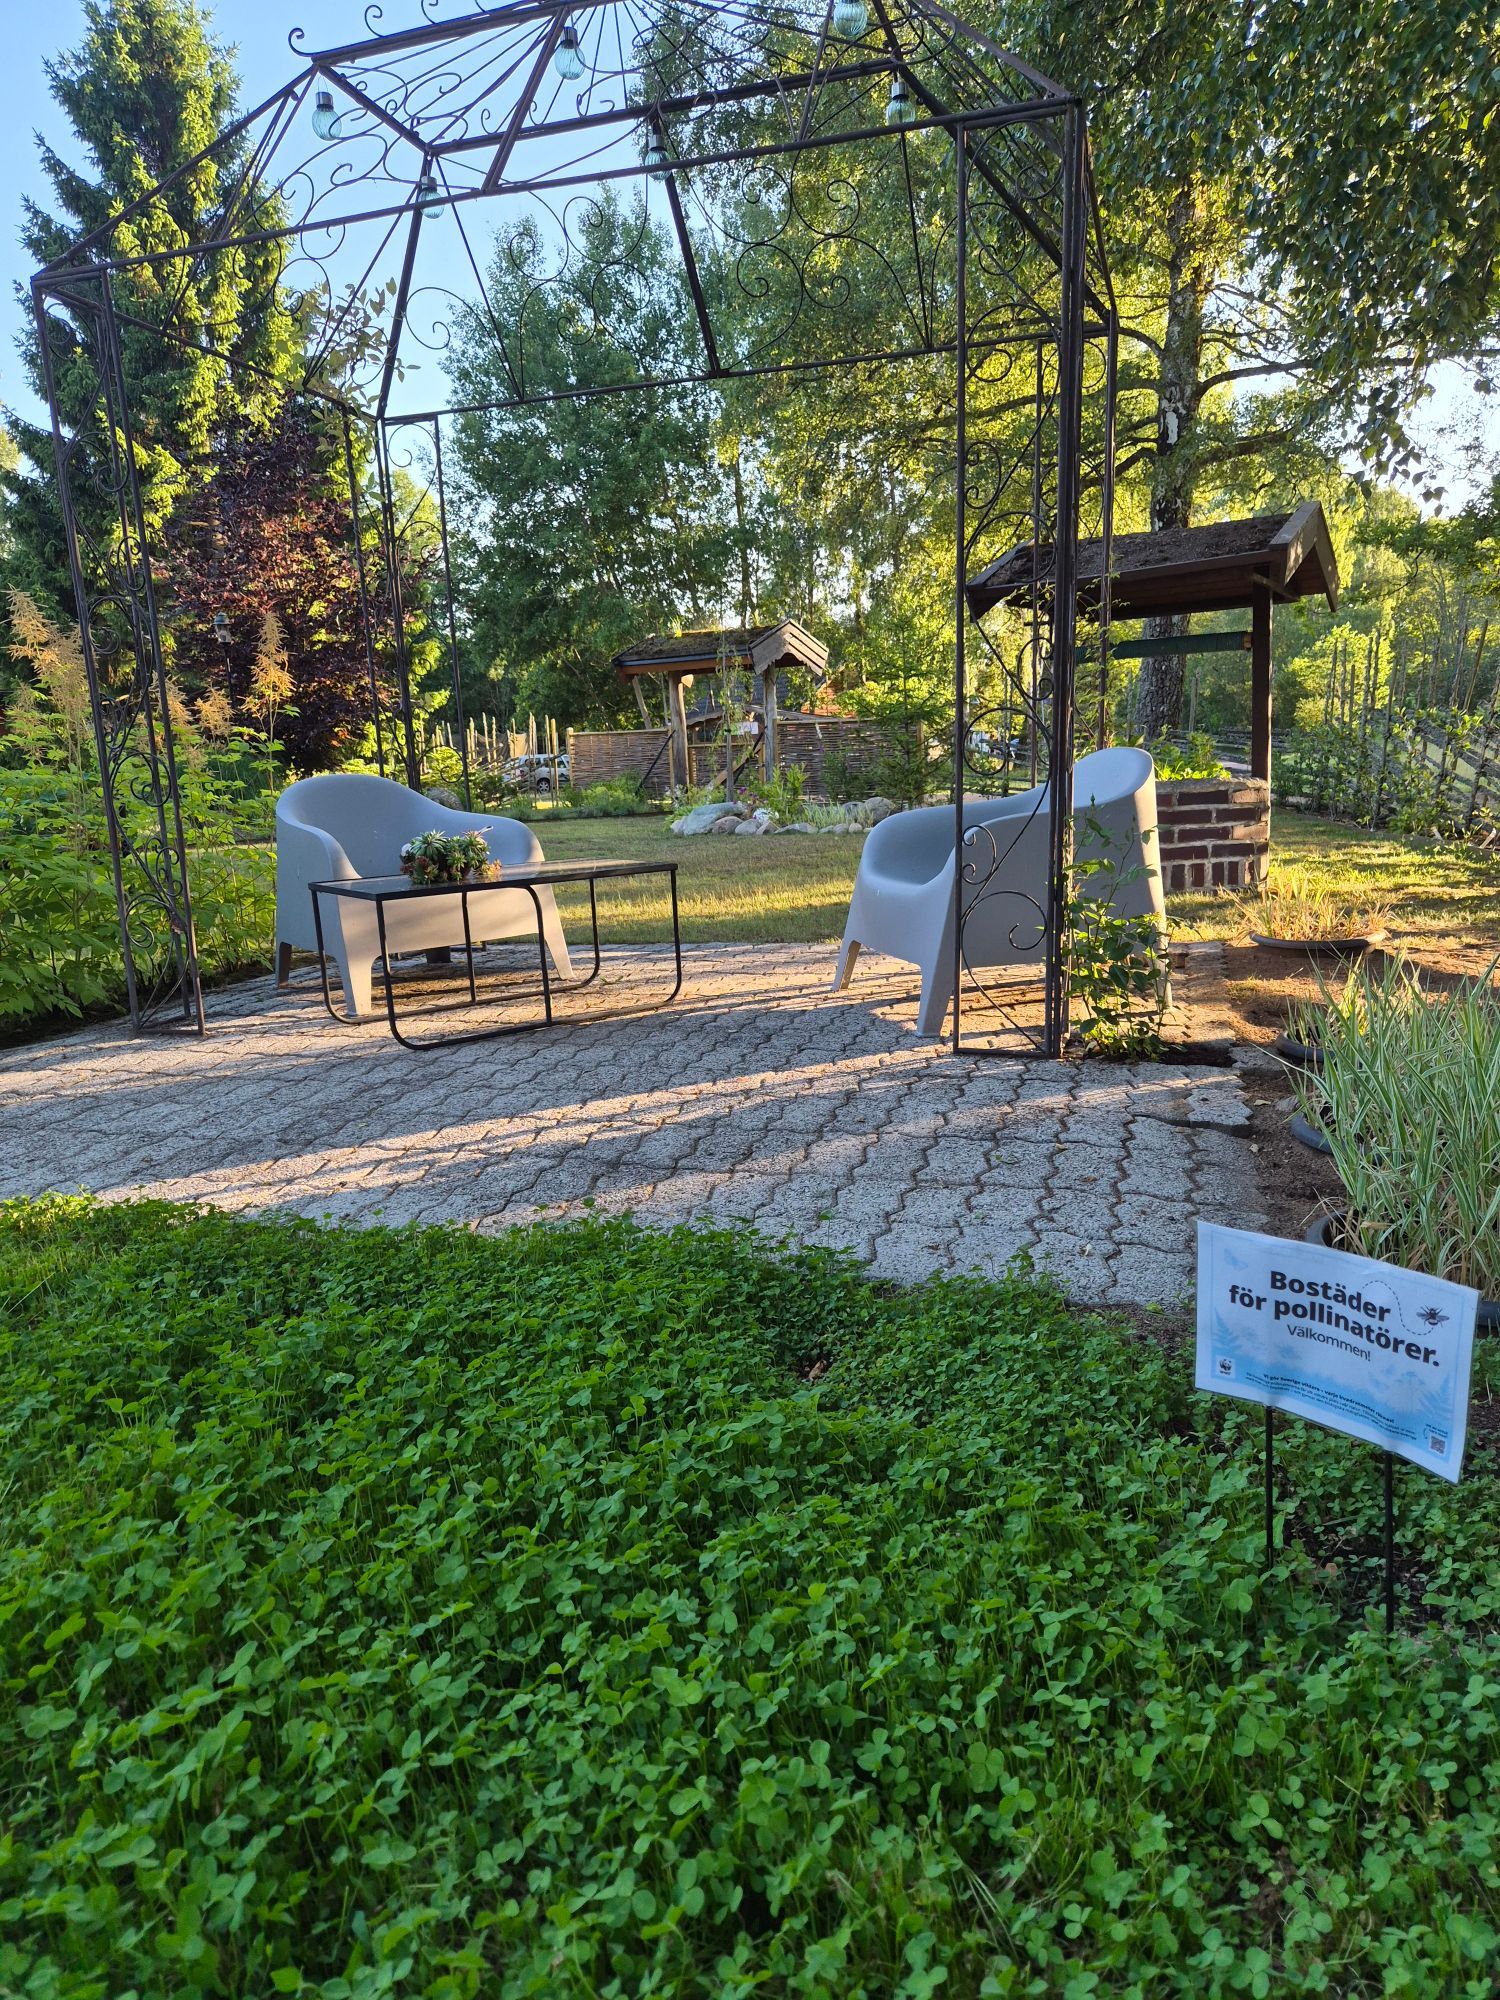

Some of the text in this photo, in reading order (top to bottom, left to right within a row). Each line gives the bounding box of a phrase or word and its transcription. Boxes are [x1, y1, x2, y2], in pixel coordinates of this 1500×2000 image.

[1270, 1270, 1391, 1322] Bostäder
[1229, 1284, 1440, 1367] för pollinatörer.
[1286, 1323, 1371, 1362] Välkommen!
